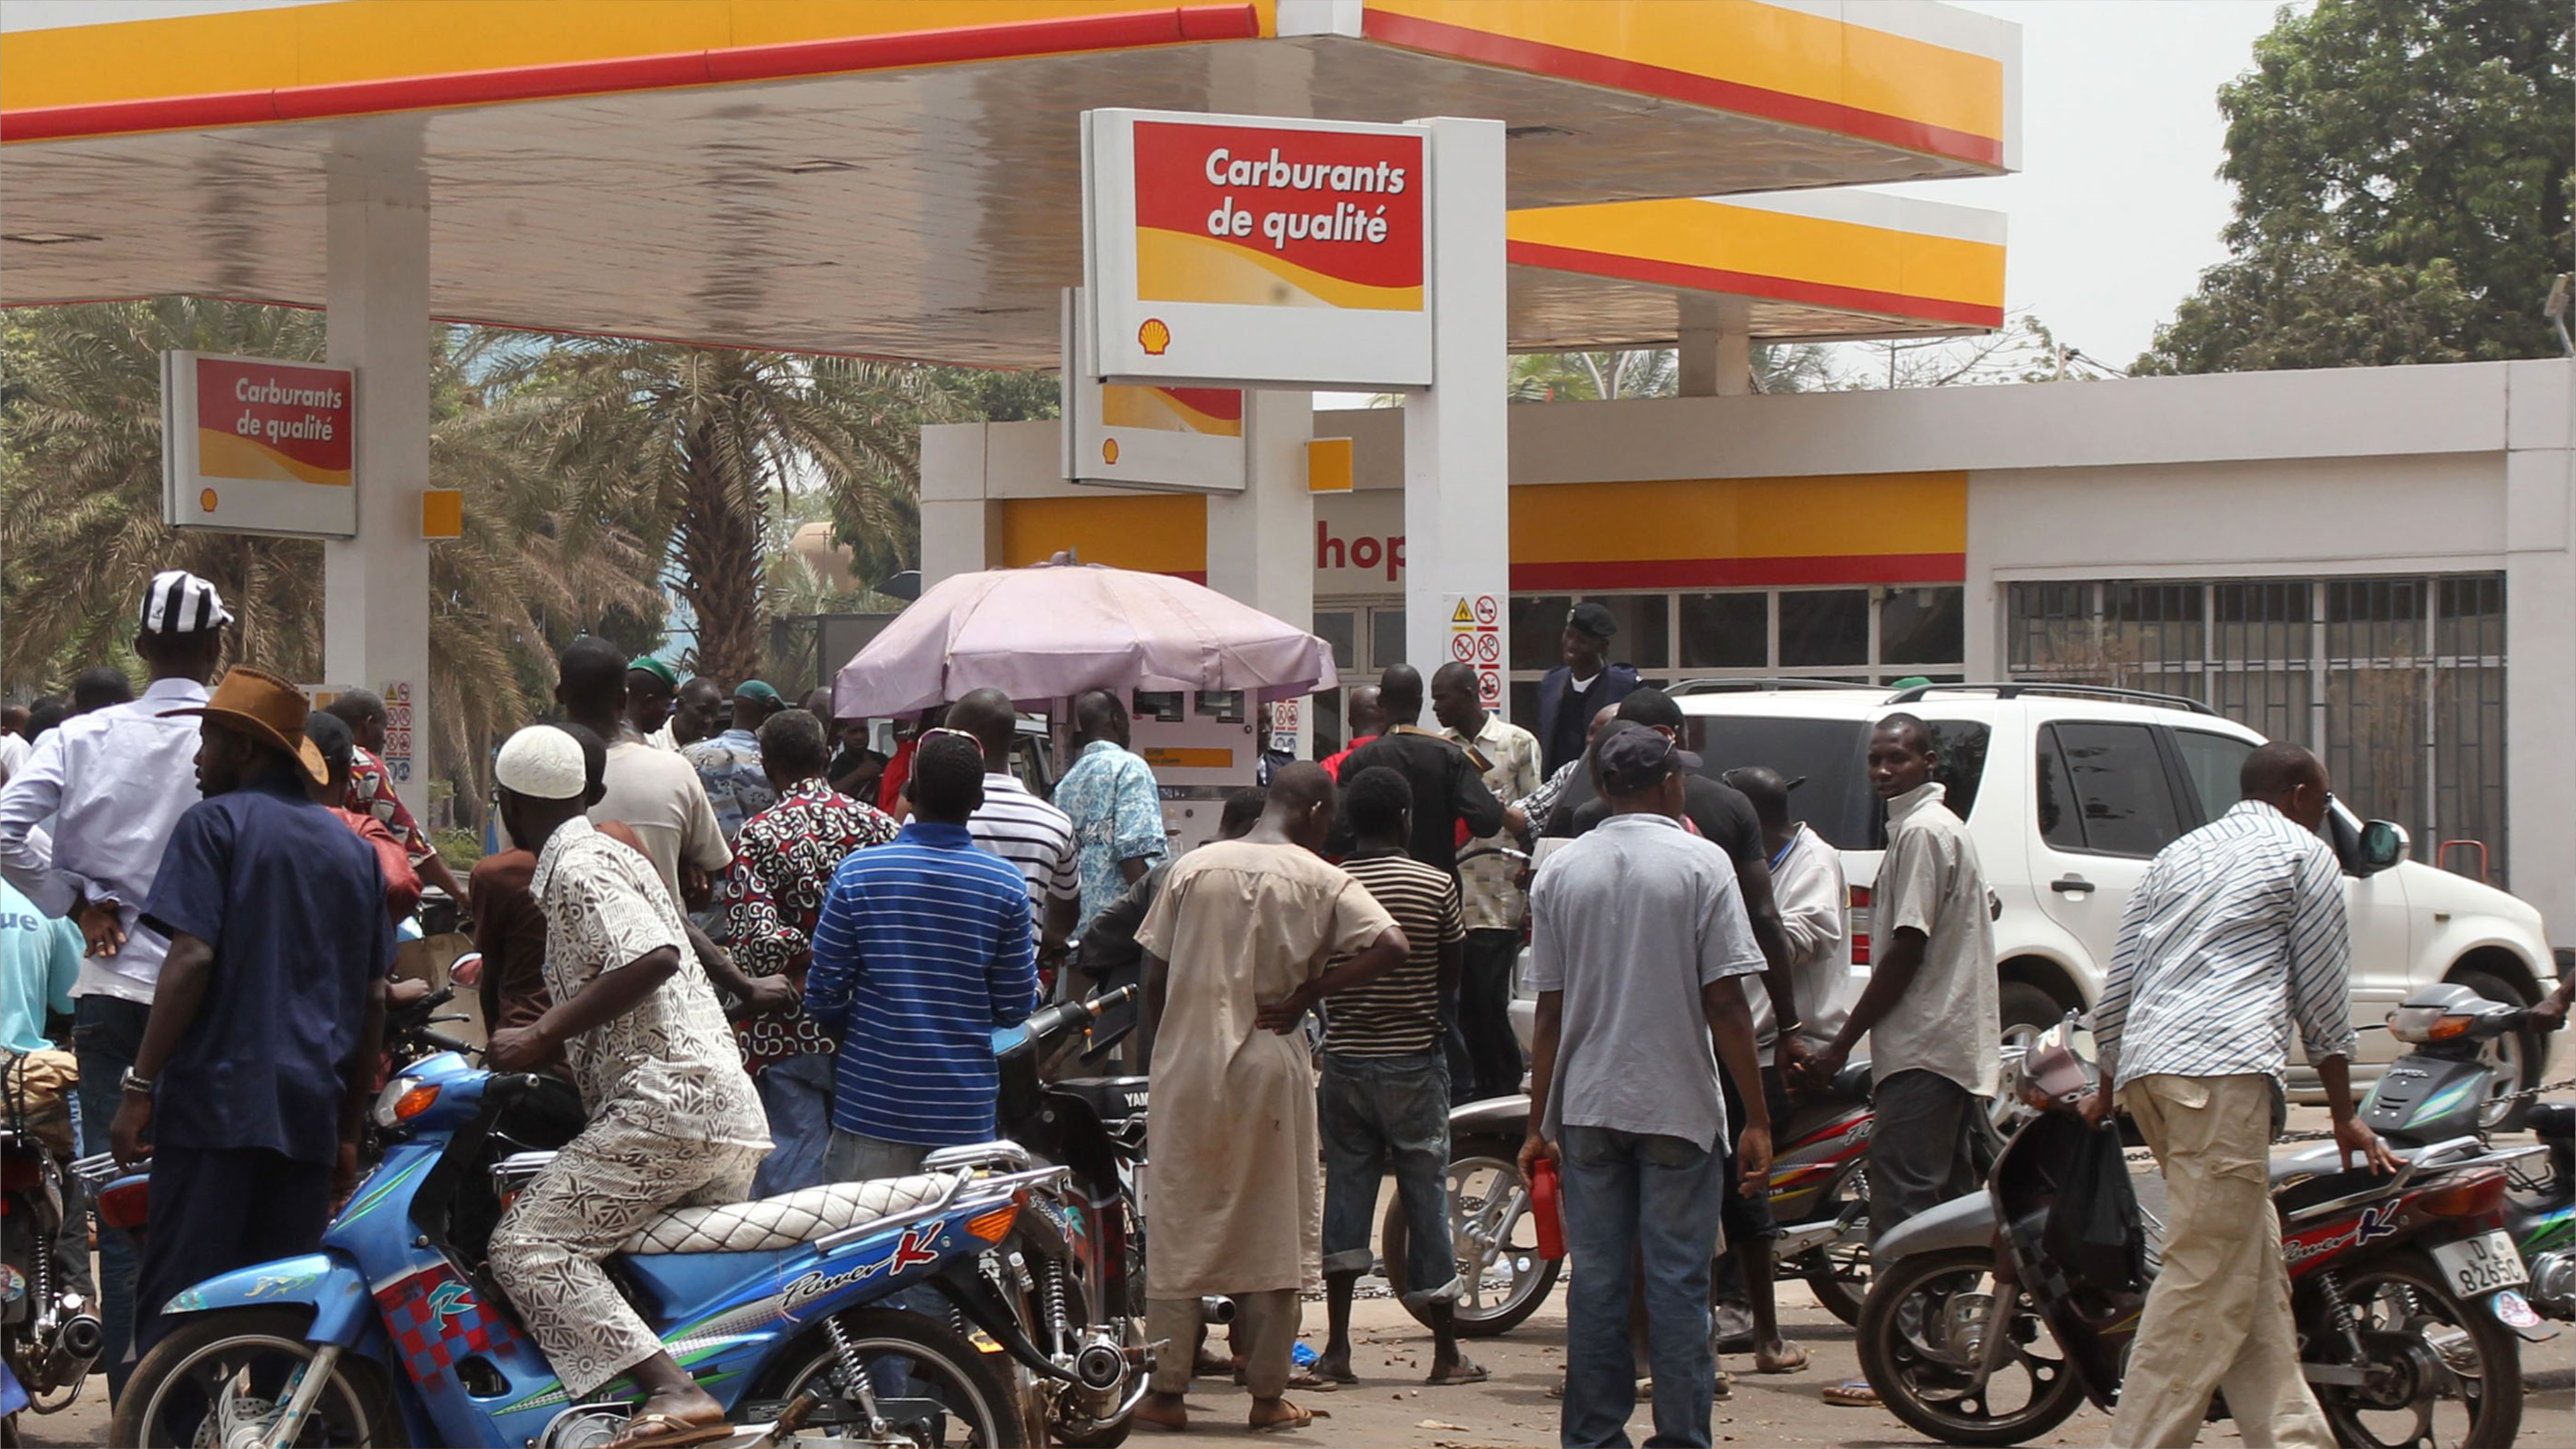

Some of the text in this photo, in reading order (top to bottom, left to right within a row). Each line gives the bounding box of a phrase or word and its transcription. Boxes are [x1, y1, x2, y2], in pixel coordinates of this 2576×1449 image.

[1205, 148, 1406, 193] Carburants
[1206, 197, 1387, 249] de qualité
[235, 378, 343, 409] Carburants
[236, 410, 333, 443] de qualité
[778, 1258, 891, 1308] Power
[889, 1220, 945, 1276] K
[2467, 1239, 2487, 1260] D
